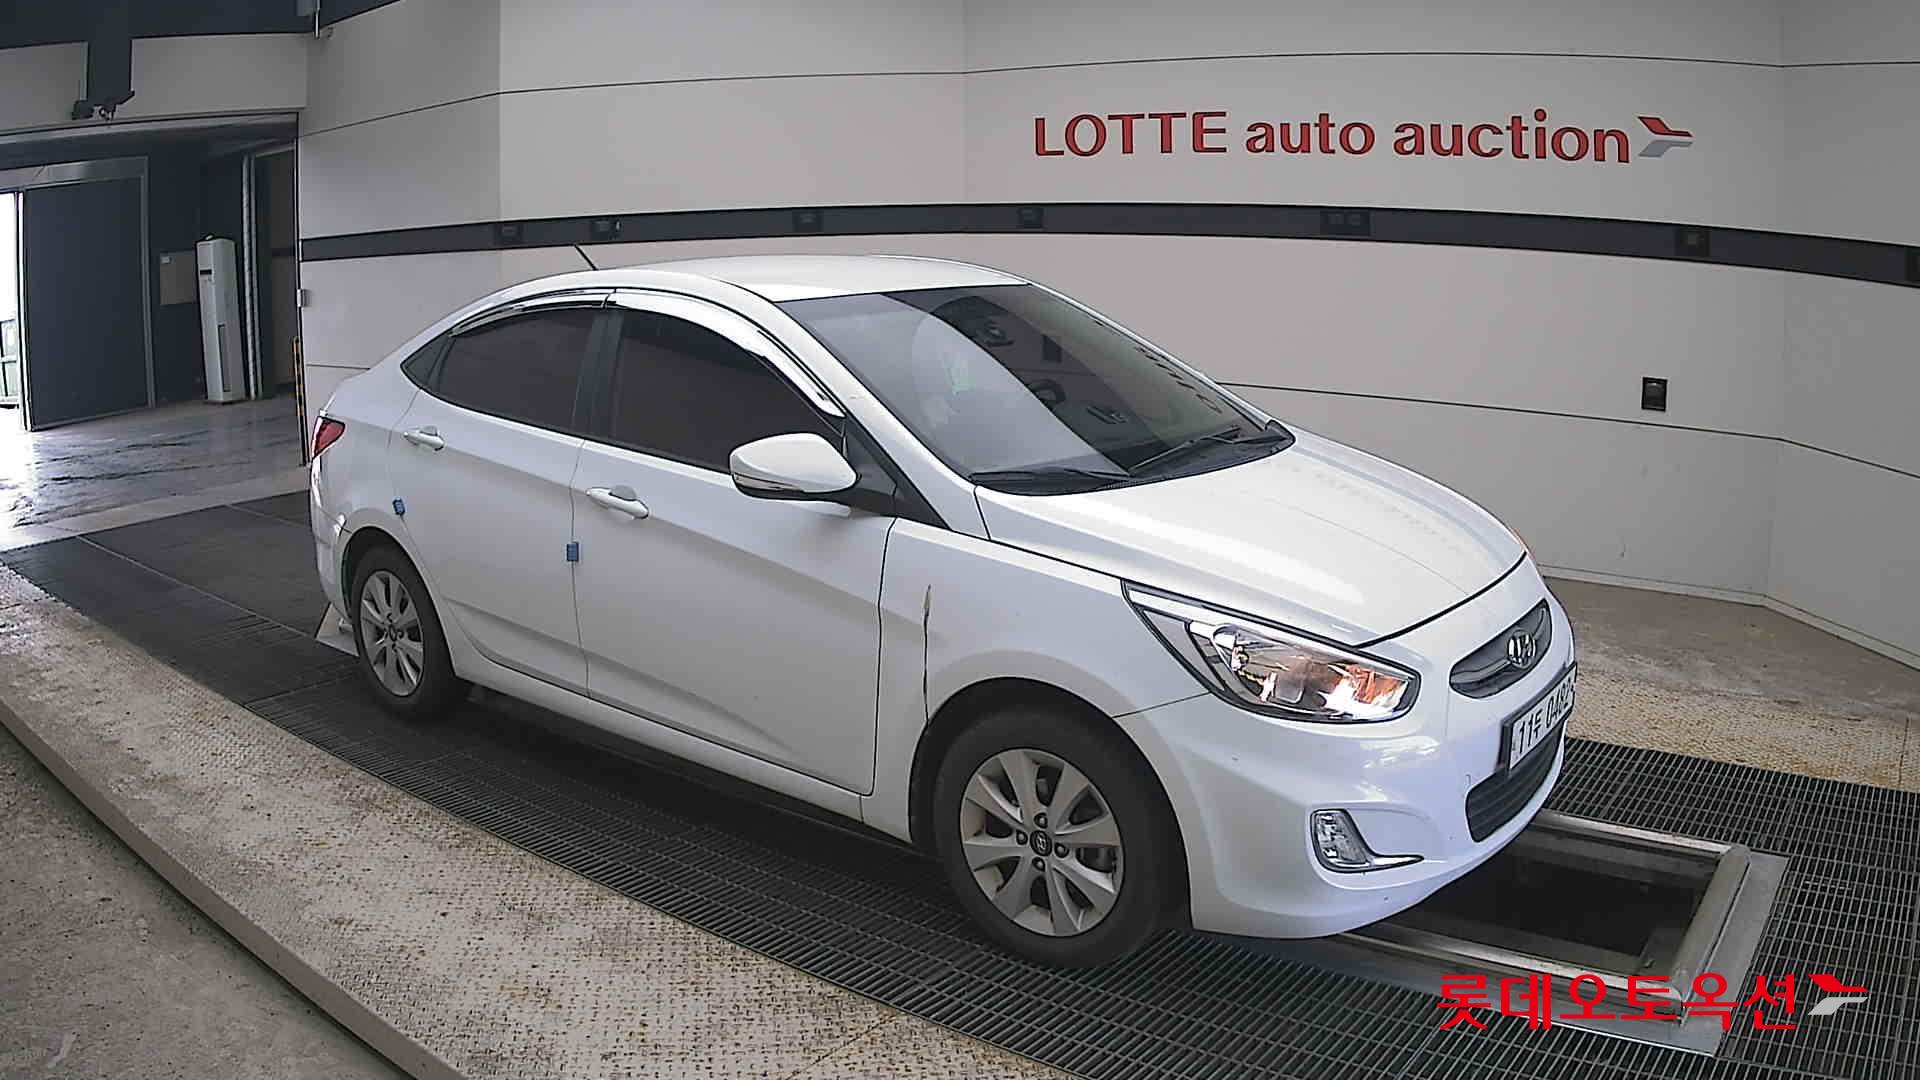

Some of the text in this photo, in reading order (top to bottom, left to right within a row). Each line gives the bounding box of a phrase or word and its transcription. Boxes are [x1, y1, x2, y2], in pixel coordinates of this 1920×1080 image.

[1034, 109, 1631, 163] LOTTE auto auction
